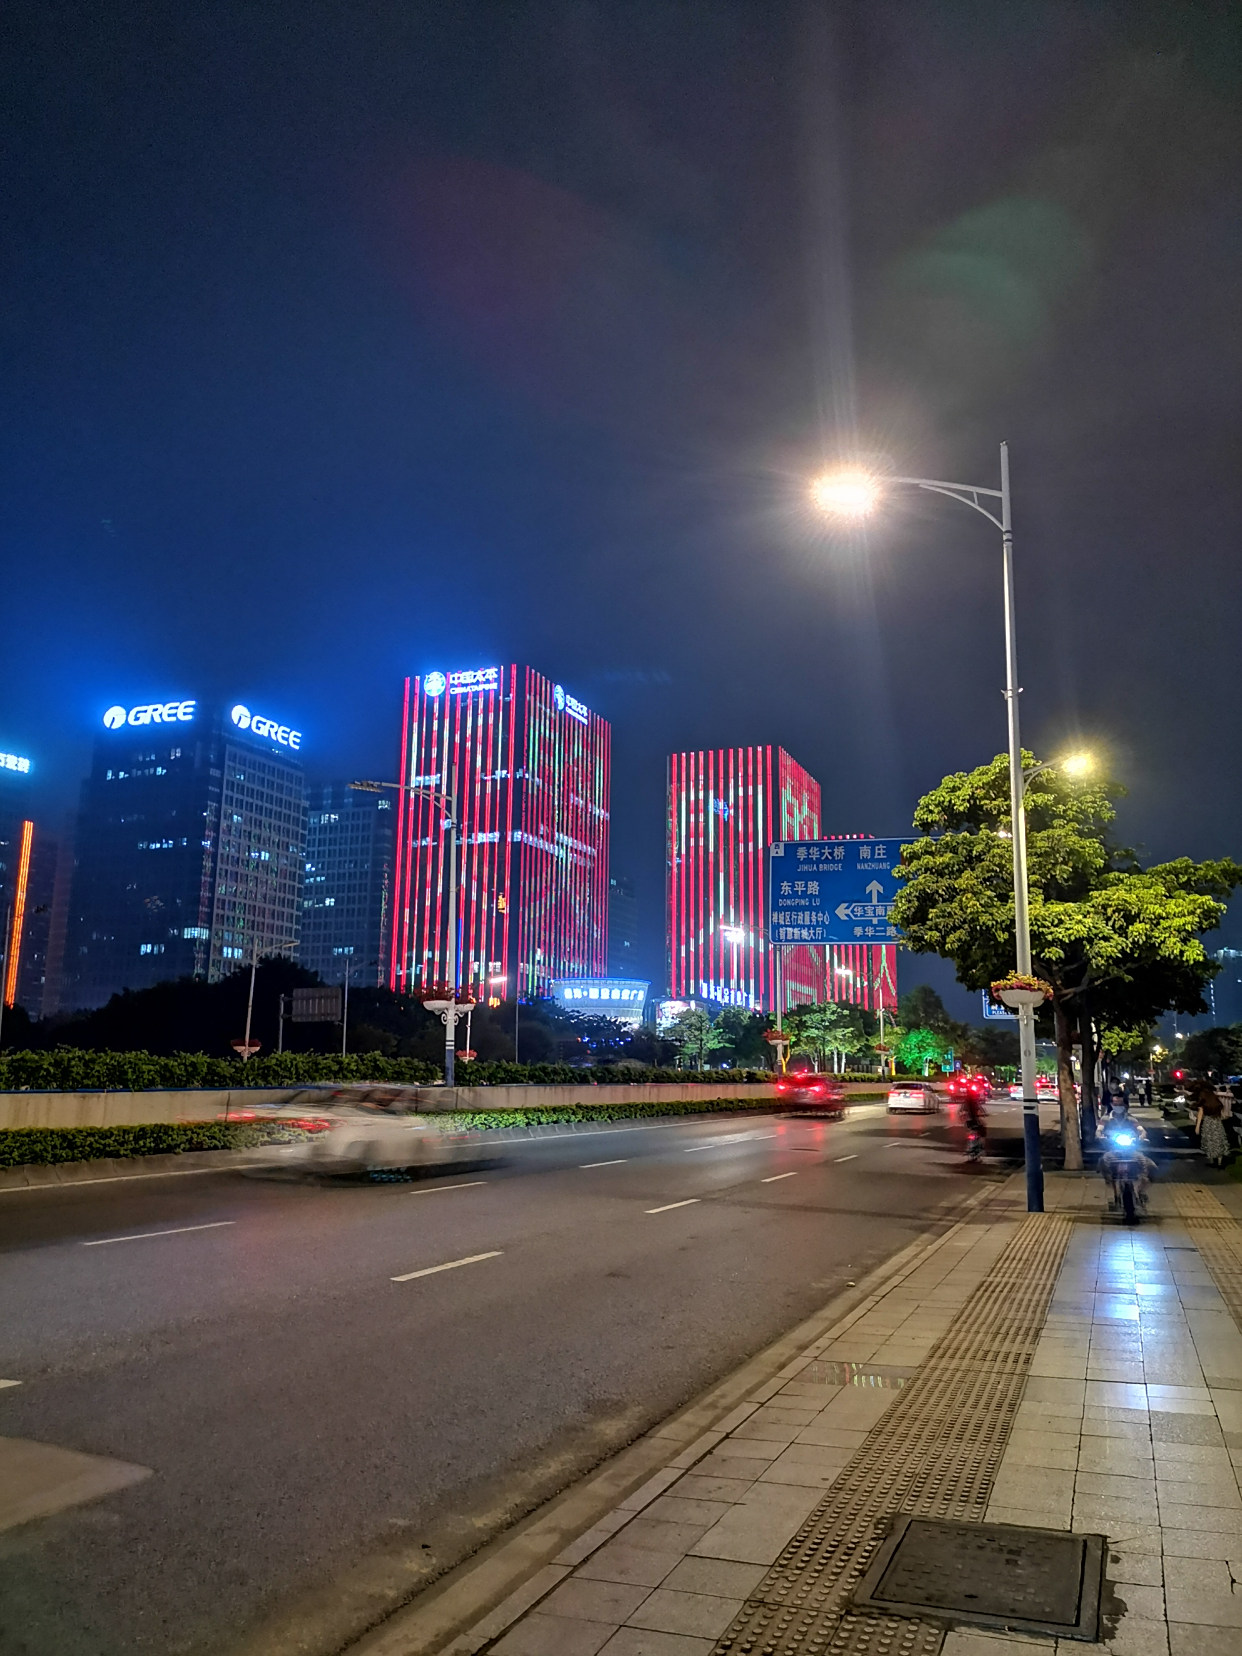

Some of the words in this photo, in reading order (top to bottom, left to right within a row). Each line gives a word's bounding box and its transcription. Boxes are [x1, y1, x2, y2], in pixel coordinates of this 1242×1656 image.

[127, 700, 196, 726] GREE
[250, 715, 303, 750] GREE
[796, 846, 845, 861] 季华大桥
[859, 844, 887, 860] 南庄
[797, 864, 817, 872] JIHUA
[819, 863, 842, 872] BRIDGE
[857, 862, 890, 870] NANZHUANG
[780, 881, 820, 895] 东平路
[779, 898, 809, 906] DONGPING
[772, 911, 830, 925] 禅城区行政服务中心
[853, 926, 897, 937] 季华二路
